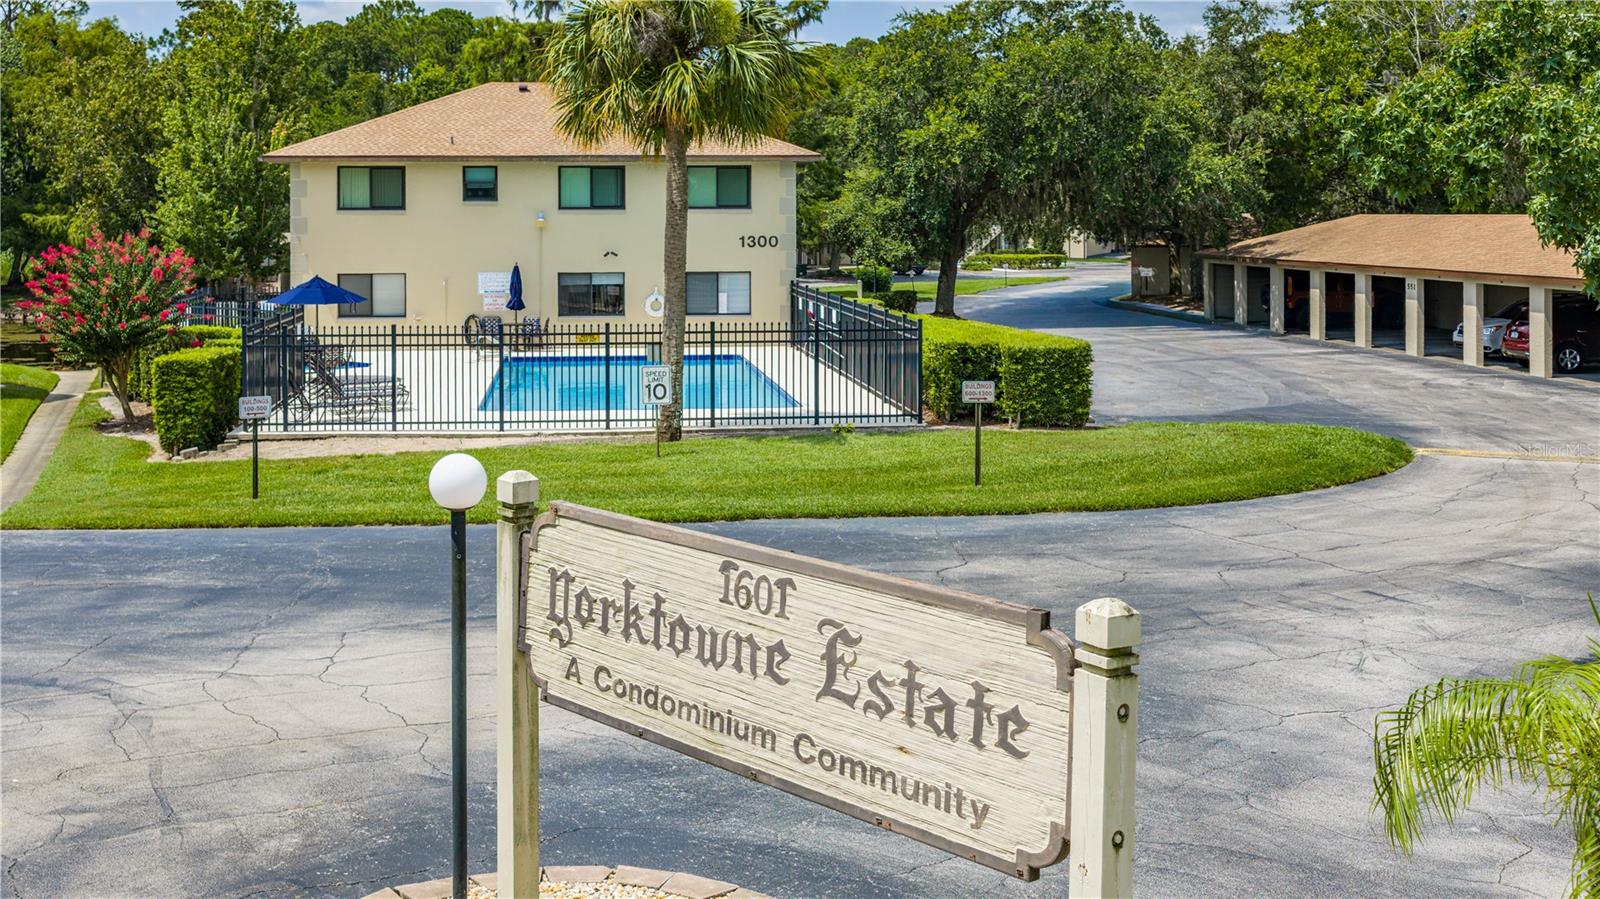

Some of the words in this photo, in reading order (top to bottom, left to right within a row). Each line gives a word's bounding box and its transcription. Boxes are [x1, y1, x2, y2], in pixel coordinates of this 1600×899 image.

[739, 235, 779, 248] 1300
[645, 383, 667, 400] 10
[719, 559, 797, 620] 1601
[547, 566, 792, 686] Yorktowne
[815, 617, 1031, 760] Estate
[564, 656, 583, 685] A
[593, 665, 777, 753] Condominium
[793, 732, 991, 830] Community
